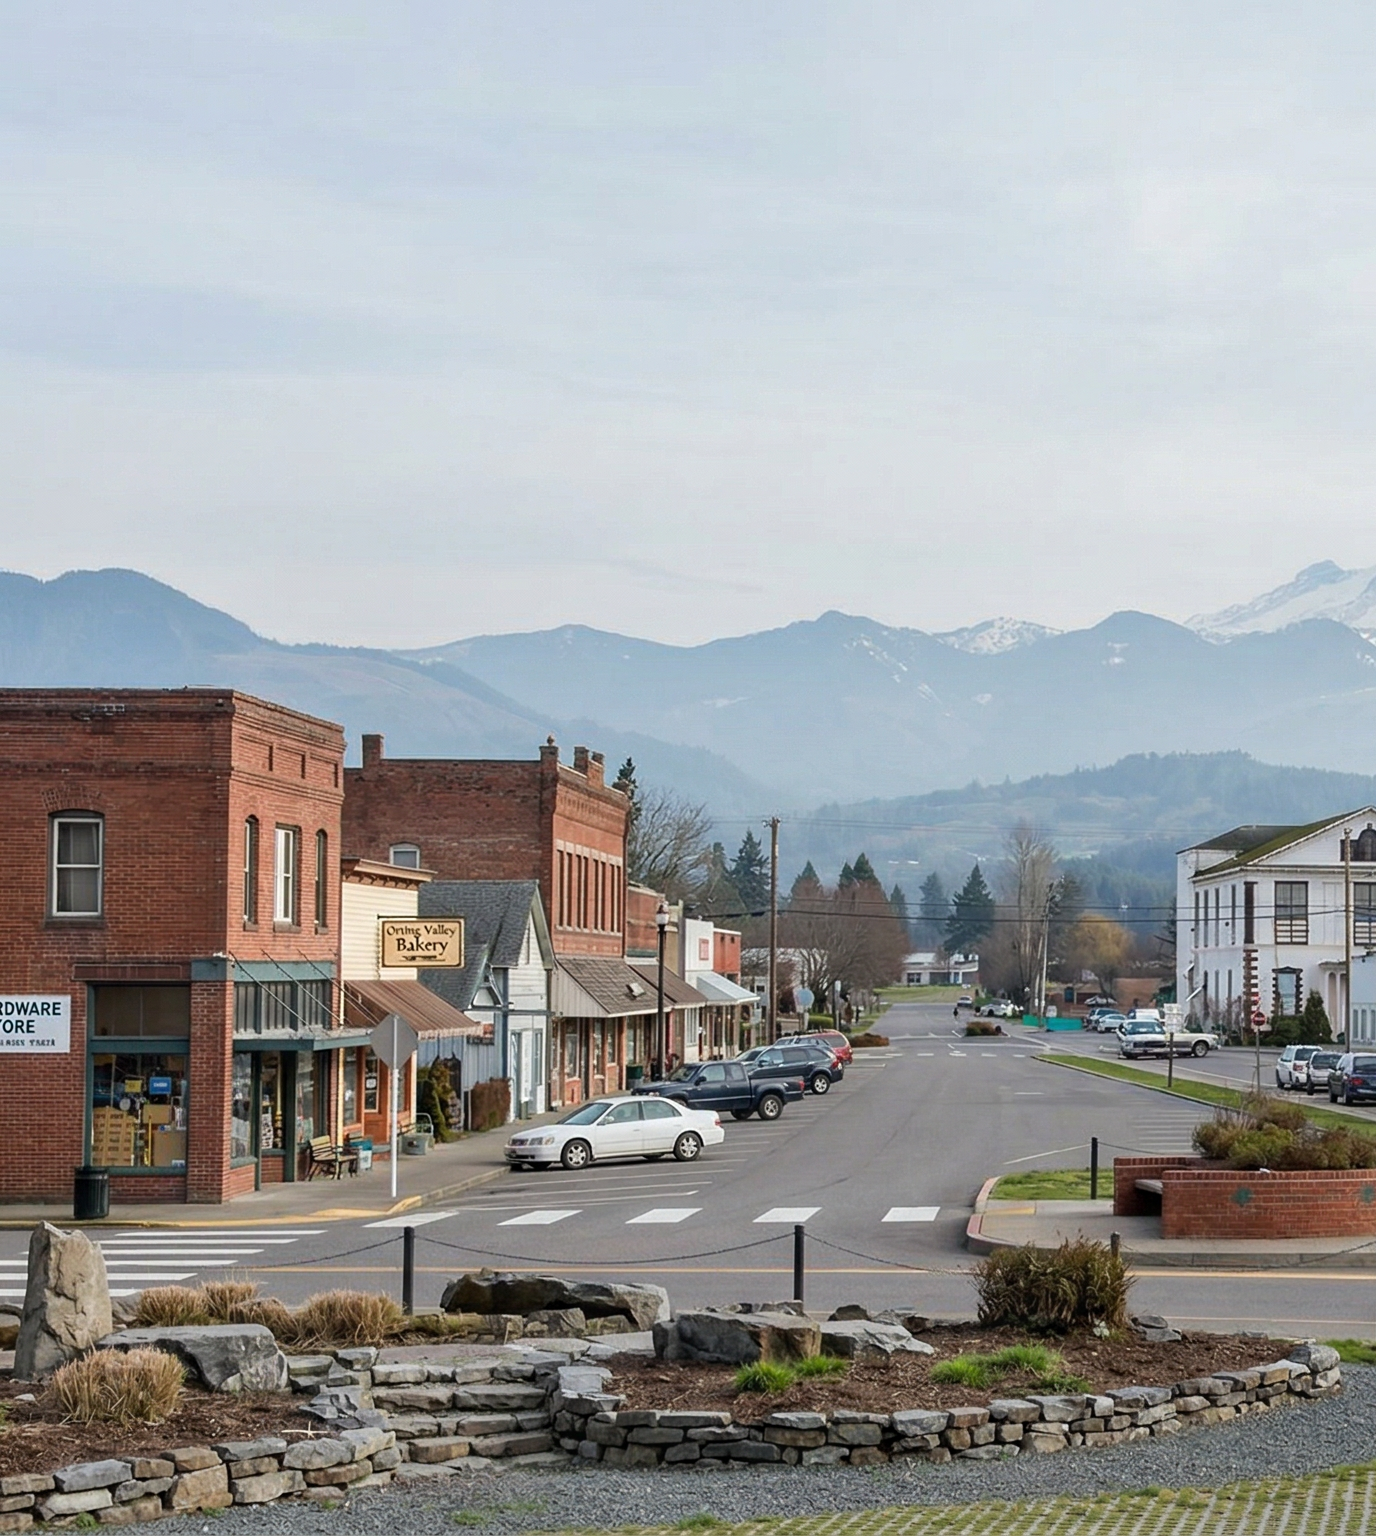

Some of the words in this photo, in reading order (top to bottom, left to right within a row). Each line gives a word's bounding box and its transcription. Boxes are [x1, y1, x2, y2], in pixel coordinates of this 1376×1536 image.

[424, 924, 457, 938] Valley
[396, 936, 448, 956] Bakery
[0, 1019, 36, 1034] ORE
